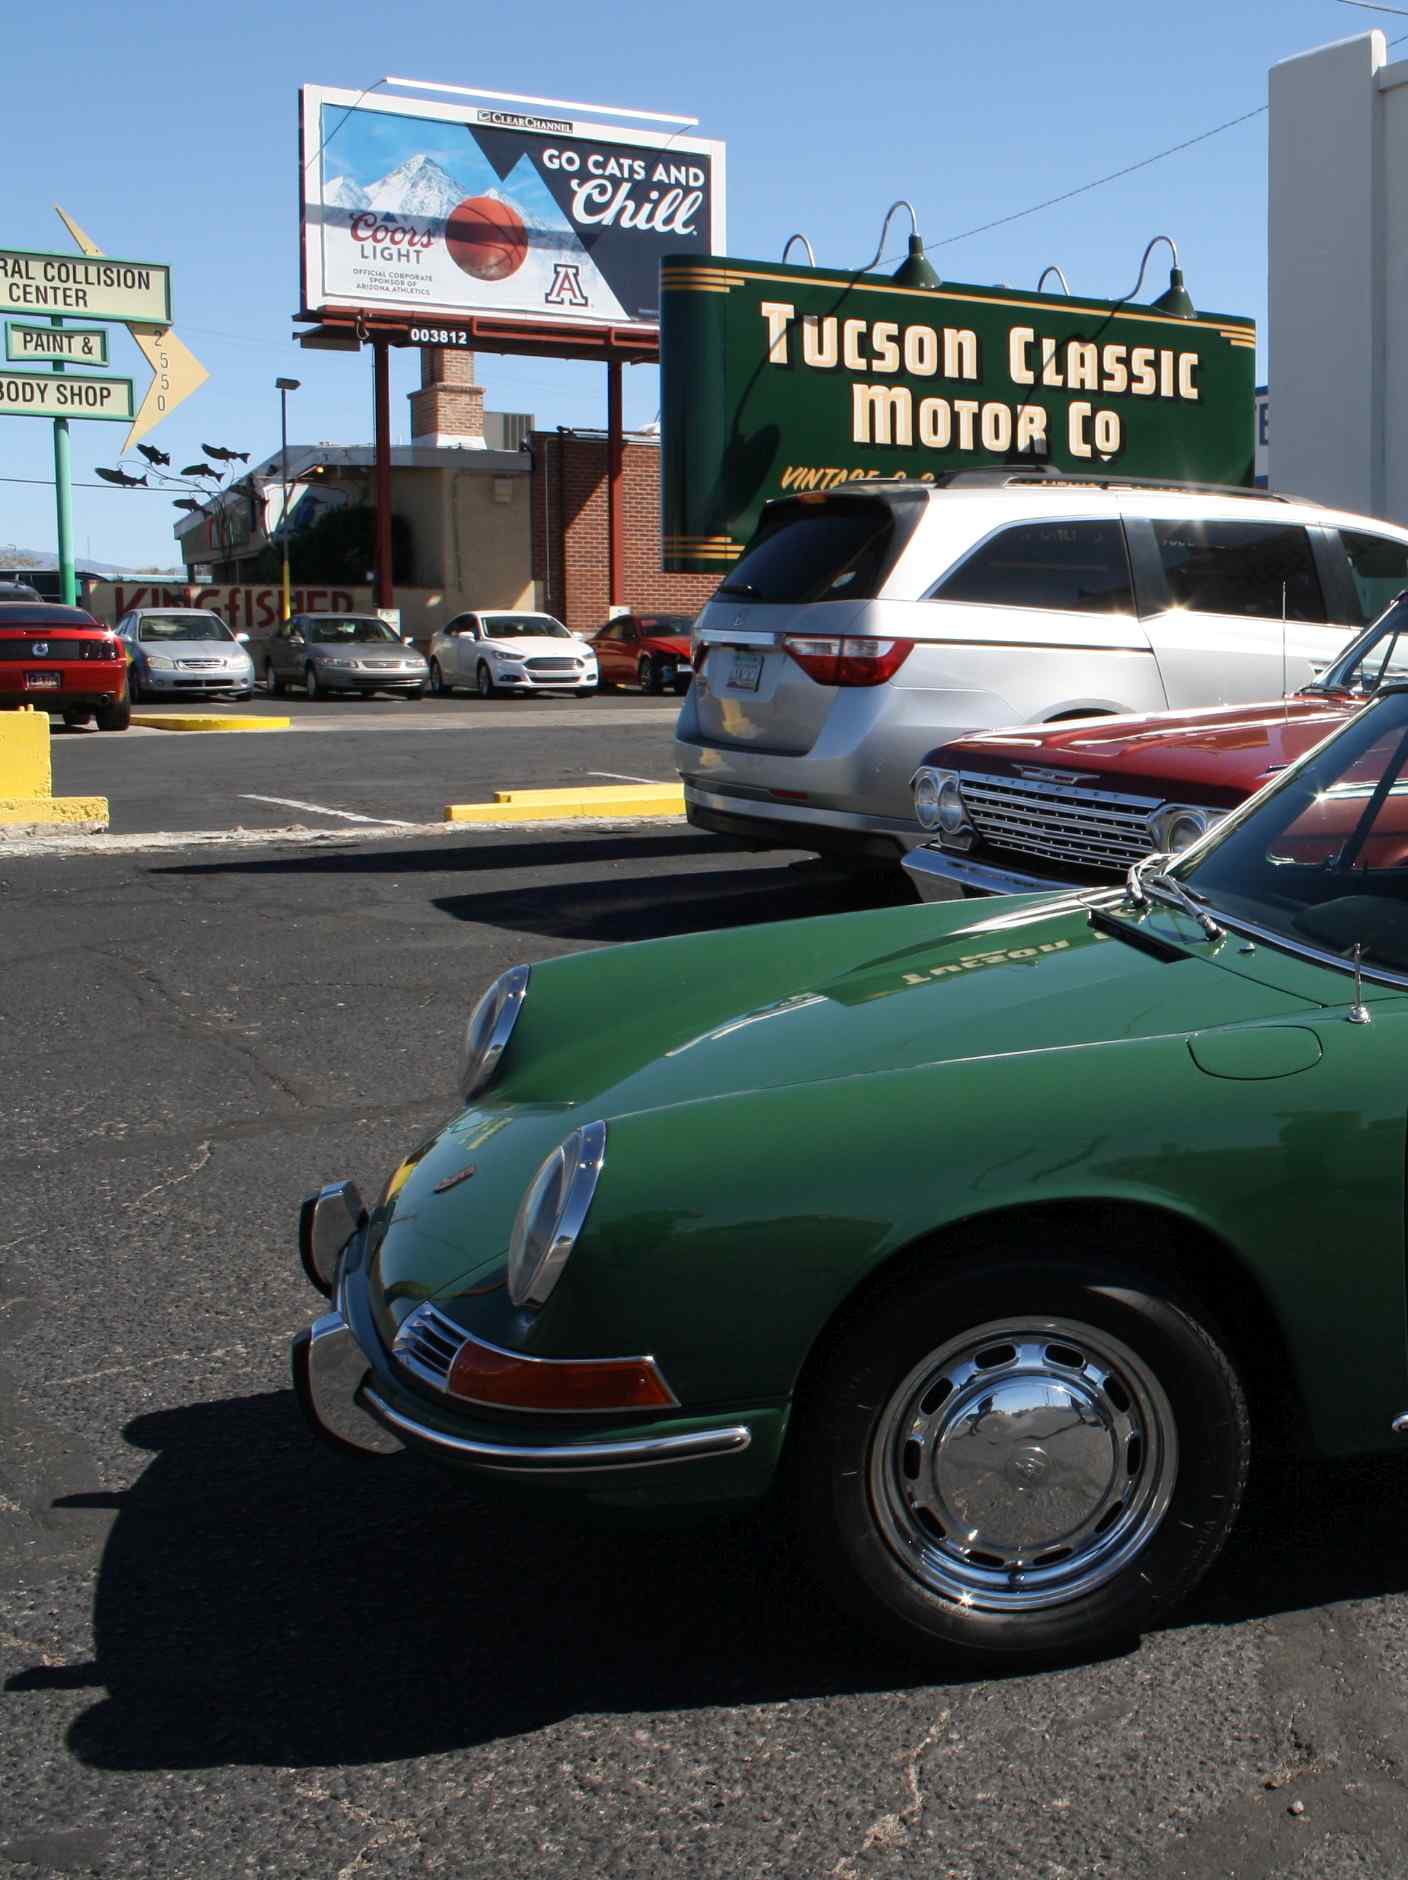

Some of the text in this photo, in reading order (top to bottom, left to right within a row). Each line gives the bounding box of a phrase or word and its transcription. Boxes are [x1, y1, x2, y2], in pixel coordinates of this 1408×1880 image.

[542, 148, 706, 188] GO CATS AND
[349, 211, 434, 249] Coors
[360, 243, 424, 265] LIGHT
[43, 261, 151, 290] COLLISION
[352, 268, 433, 282] OFFICIAL CORPORATE
[368, 277, 406, 286] SPONSOR
[545, 263, 588, 307] A
[8, 282, 89, 308] CENTER
[356, 283, 431, 296] ARIZONA ATHLETICS
[22, 331, 94, 355] PAINT &
[410, 328, 468, 345] 003812
[760, 301, 1200, 400] TUCSON CLASSIC
[56, 383, 112, 407] SHOP
[852, 382, 1049, 455] MOTOR
